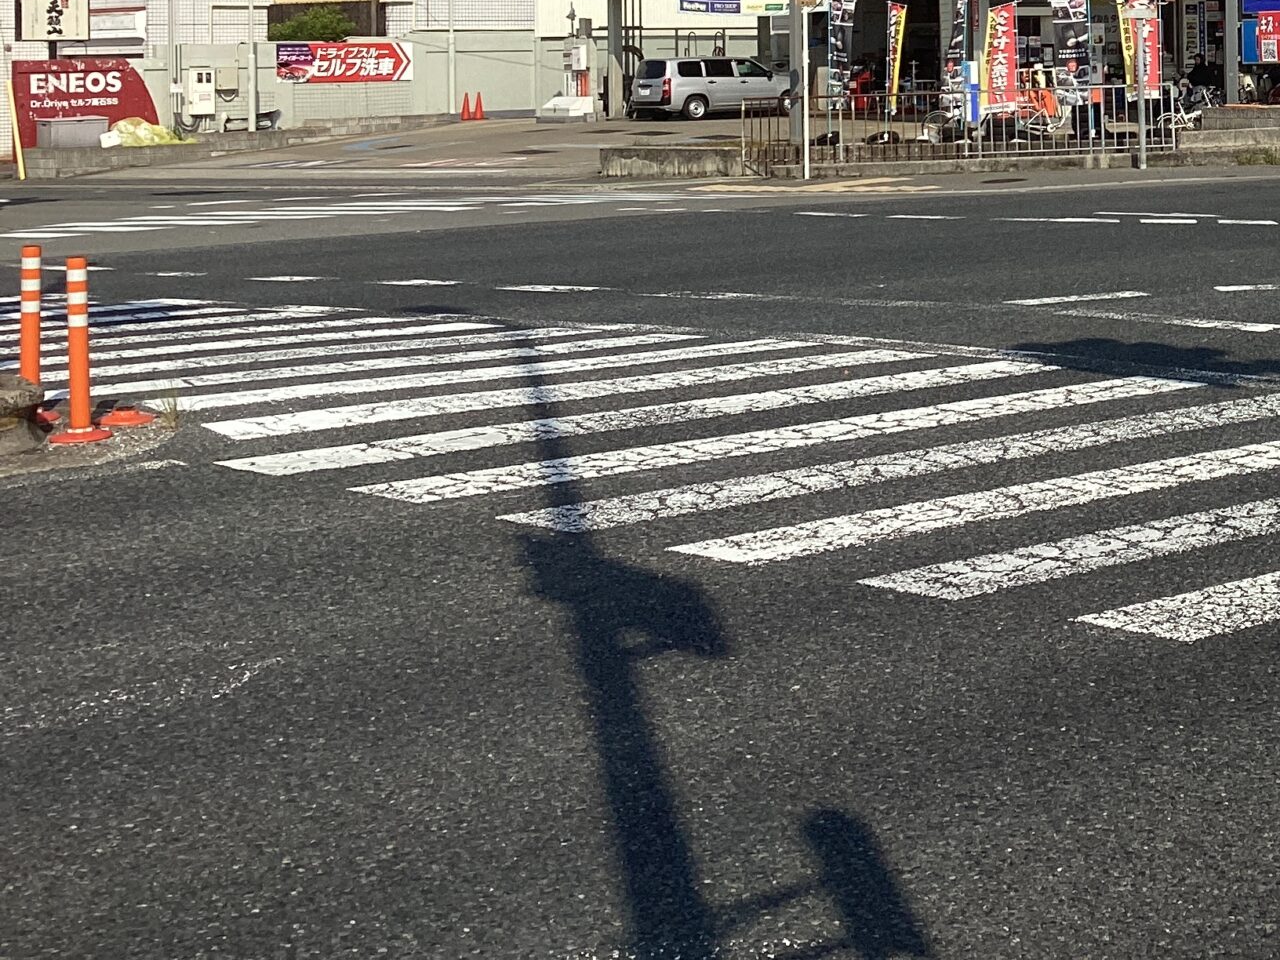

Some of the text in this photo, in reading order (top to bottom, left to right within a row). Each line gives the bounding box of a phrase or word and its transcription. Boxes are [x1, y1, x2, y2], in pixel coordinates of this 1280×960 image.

[316, 47, 390, 59] ドライブスルー
[311, 58, 396, 76] セルフ洗車
[29, 71, 122, 95] ENEOS
